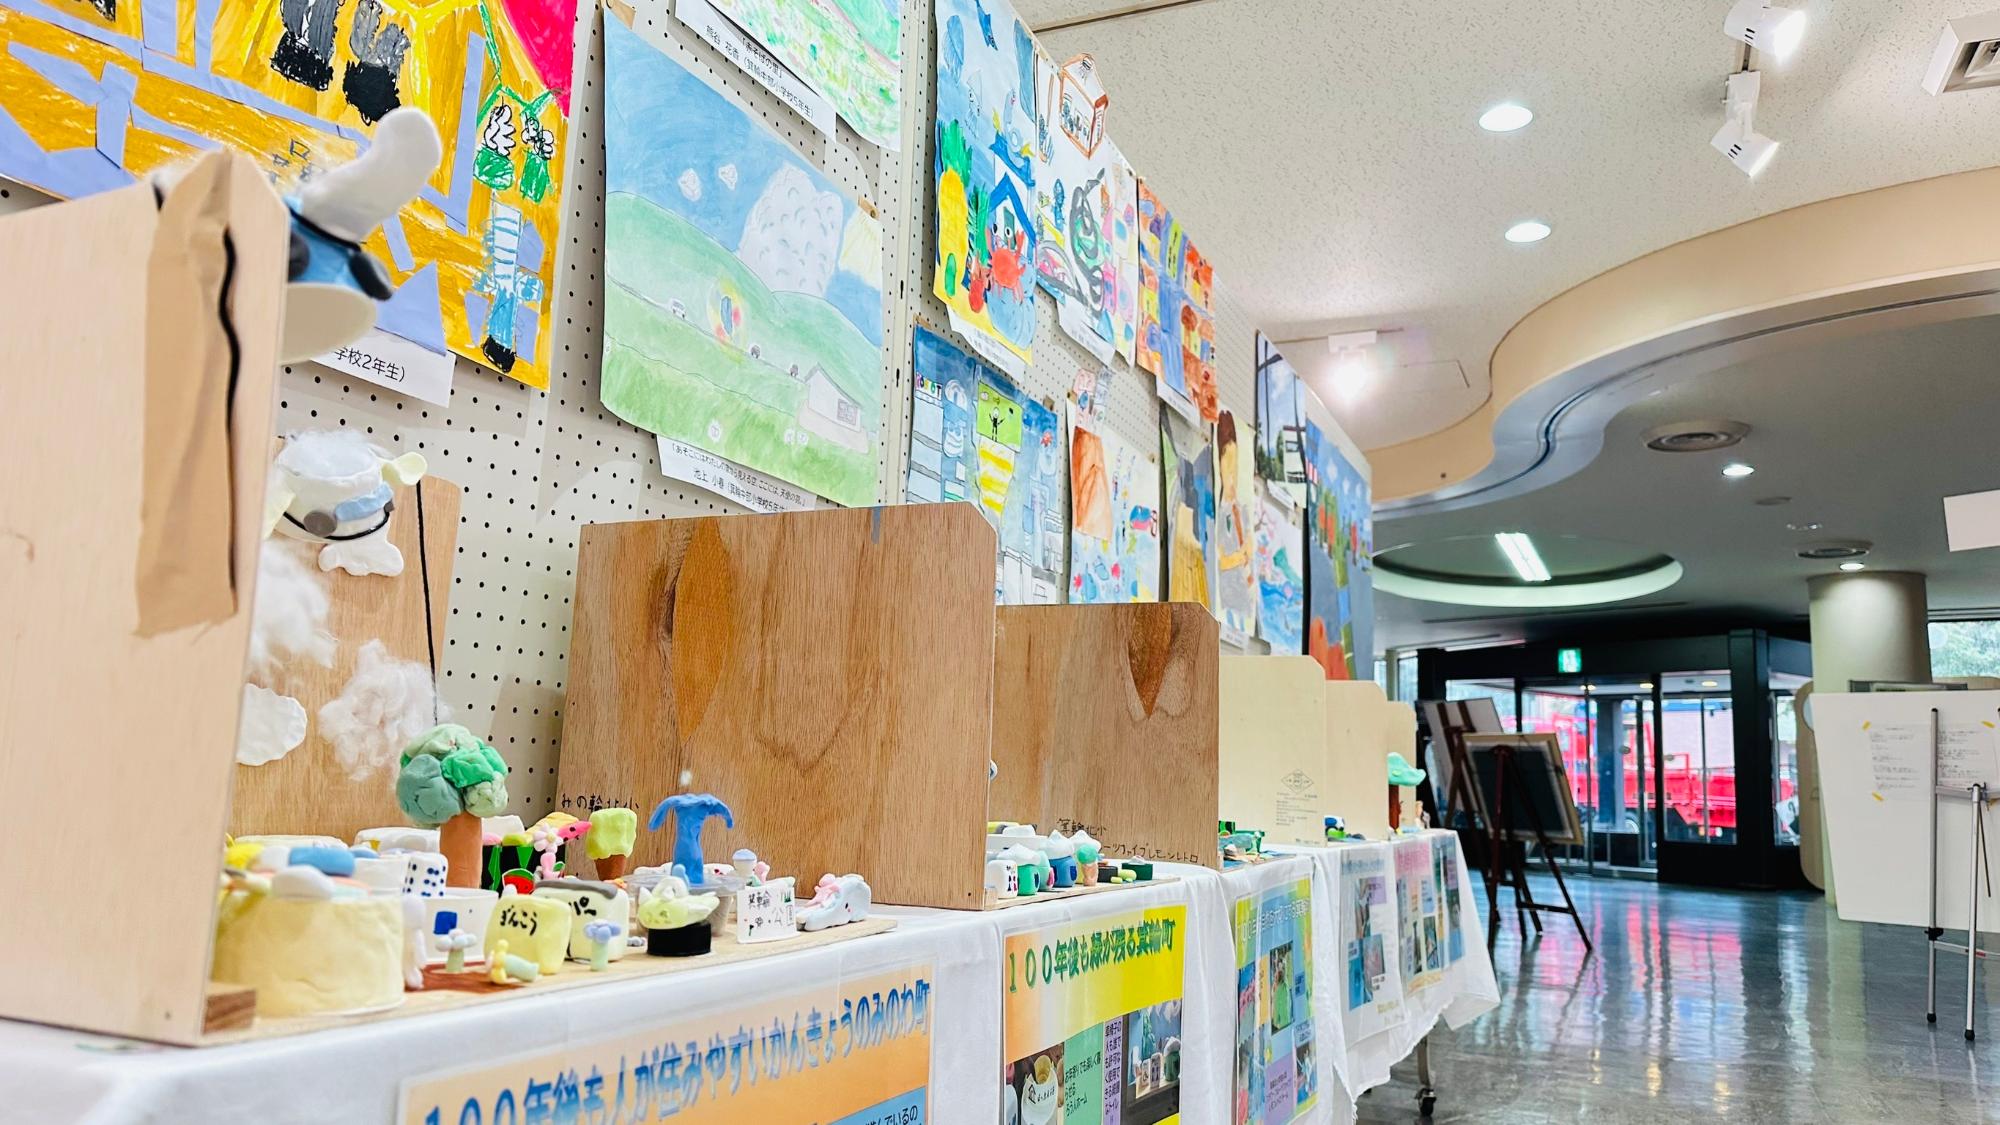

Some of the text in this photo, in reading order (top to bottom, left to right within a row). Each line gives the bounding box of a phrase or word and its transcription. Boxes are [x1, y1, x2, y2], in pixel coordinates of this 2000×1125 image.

[499, 904, 538, 936] ぎんこう
[425, 978, 931, 1125] 年後も人が住みやすいかんきょうのみのわ町
[866, 1105, 918, 1125] でいるの
